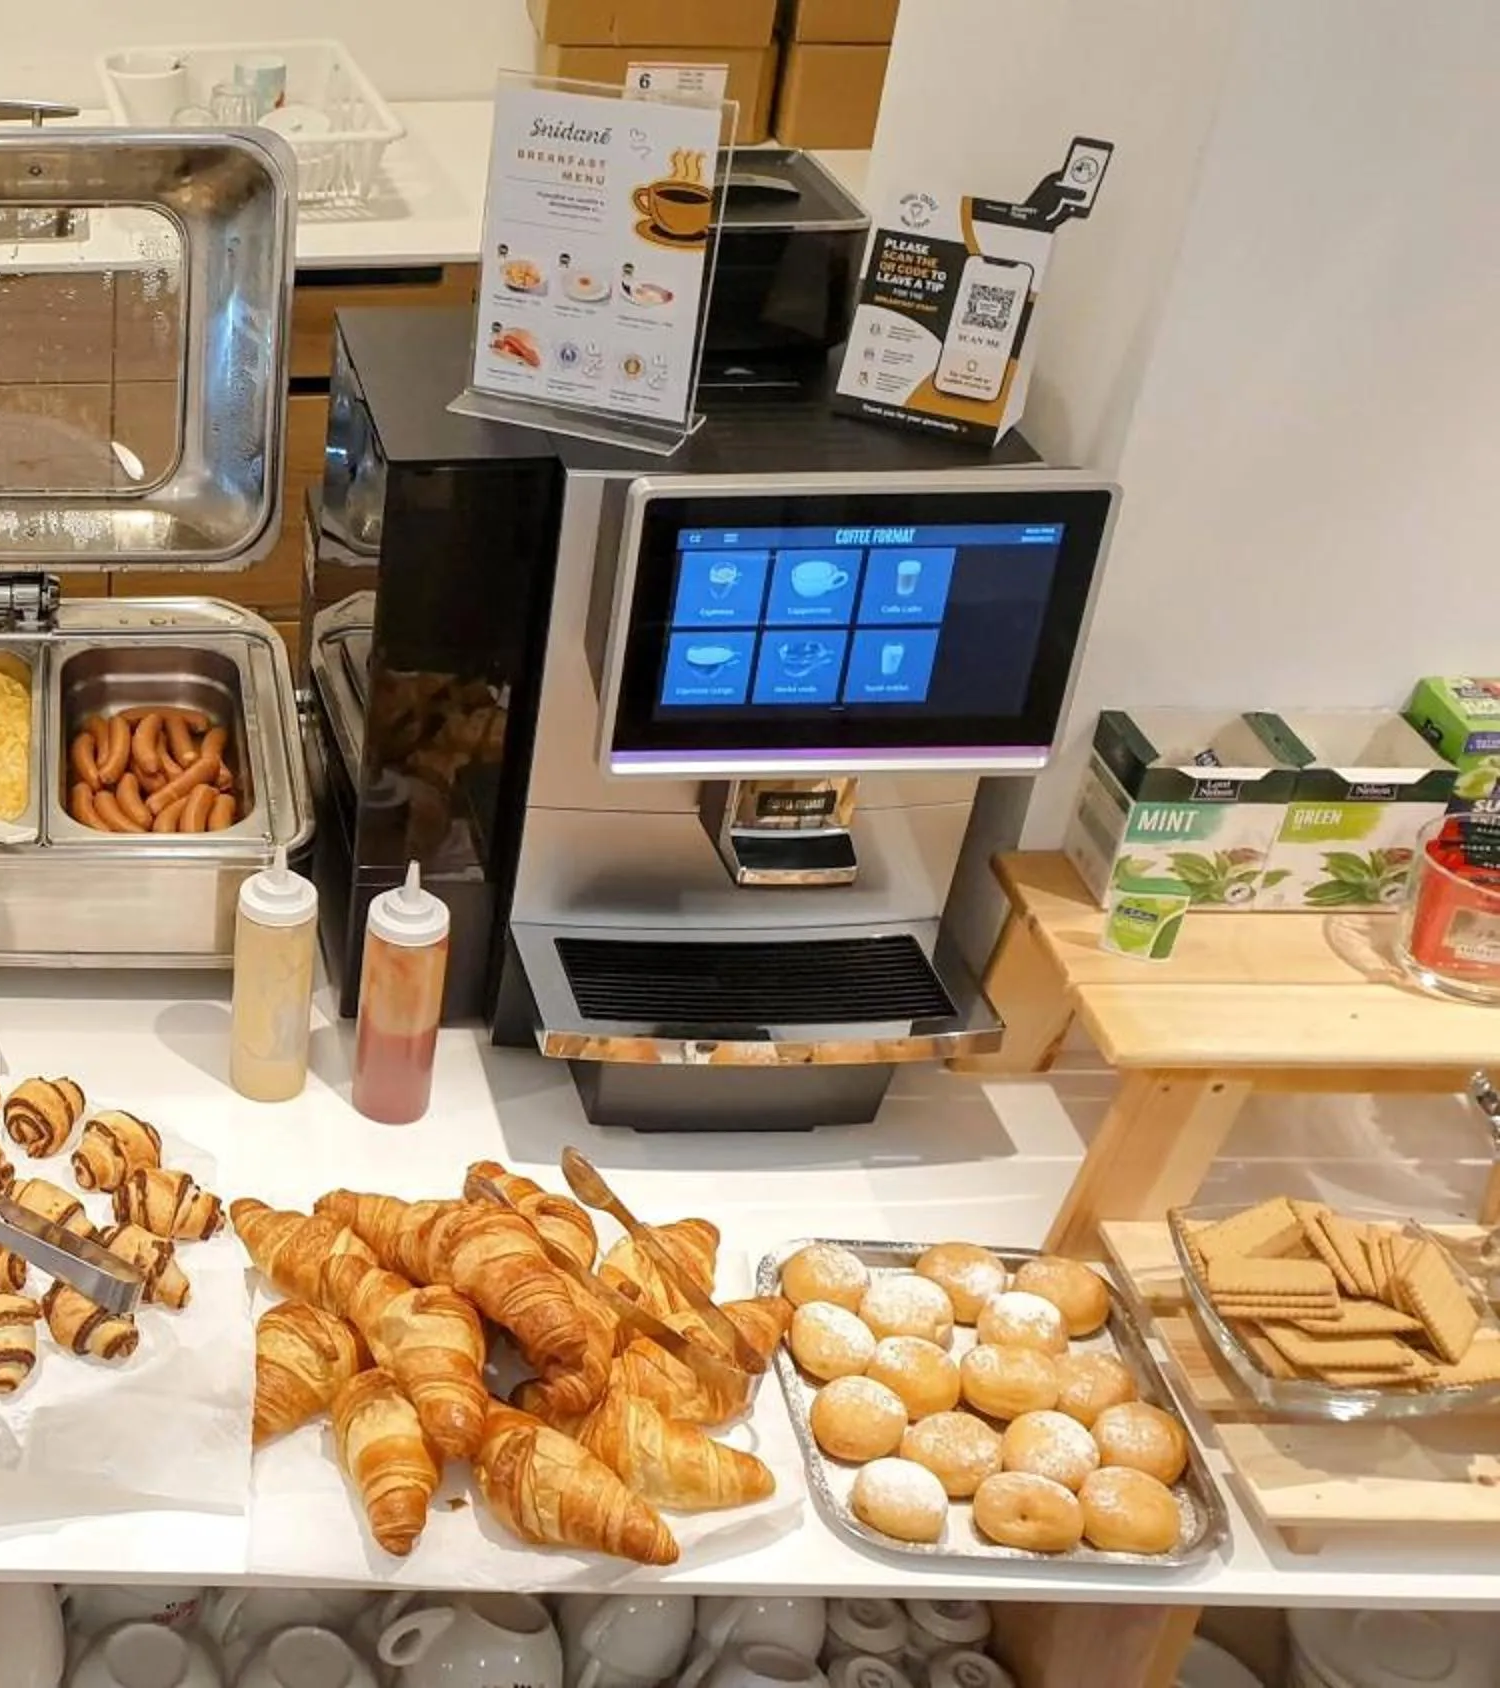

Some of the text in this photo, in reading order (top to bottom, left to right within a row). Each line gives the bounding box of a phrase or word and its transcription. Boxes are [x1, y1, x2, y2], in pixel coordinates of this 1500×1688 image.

[639, 73, 651, 89] 6
[517, 149, 606, 169] BREAKFAST
[561, 171, 605, 186] MENU
[884, 237, 930, 256] PLEASE
[881, 249, 939, 269] SCAN THE
[879, 260, 947, 281] QR CODE TO
[876, 271, 945, 293] LEAVE A TIP
[958, 333, 1000, 348] SCAN ME
[835, 528, 916, 545] COFFEE FORMAT
[1137, 809, 1199, 833] MINT
[1293, 809, 1343, 825] GREEN
